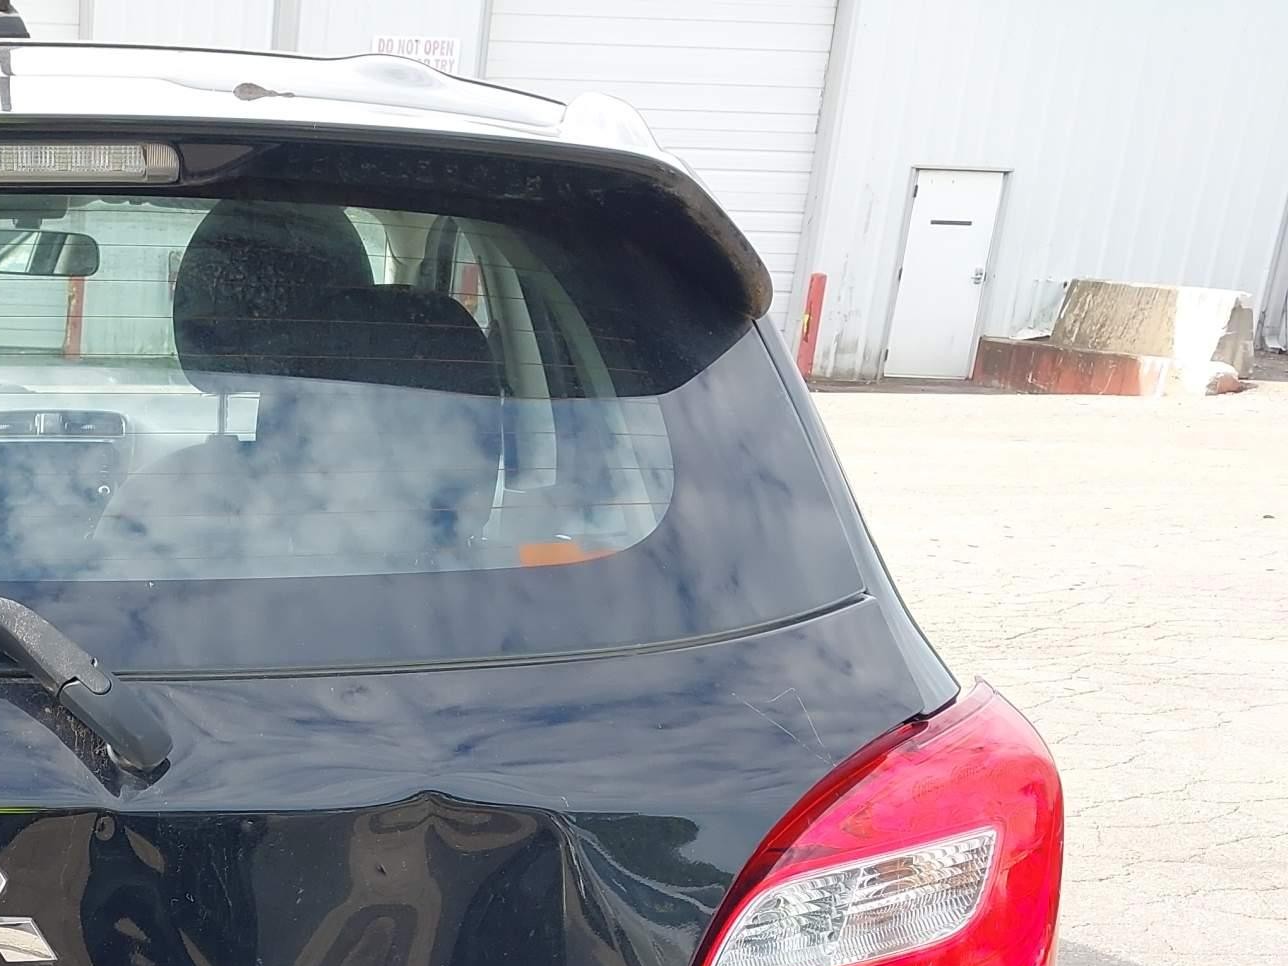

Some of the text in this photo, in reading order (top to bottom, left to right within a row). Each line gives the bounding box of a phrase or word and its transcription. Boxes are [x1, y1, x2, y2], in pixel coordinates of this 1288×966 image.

[378, 38, 455, 57] DO NOT OPEN
